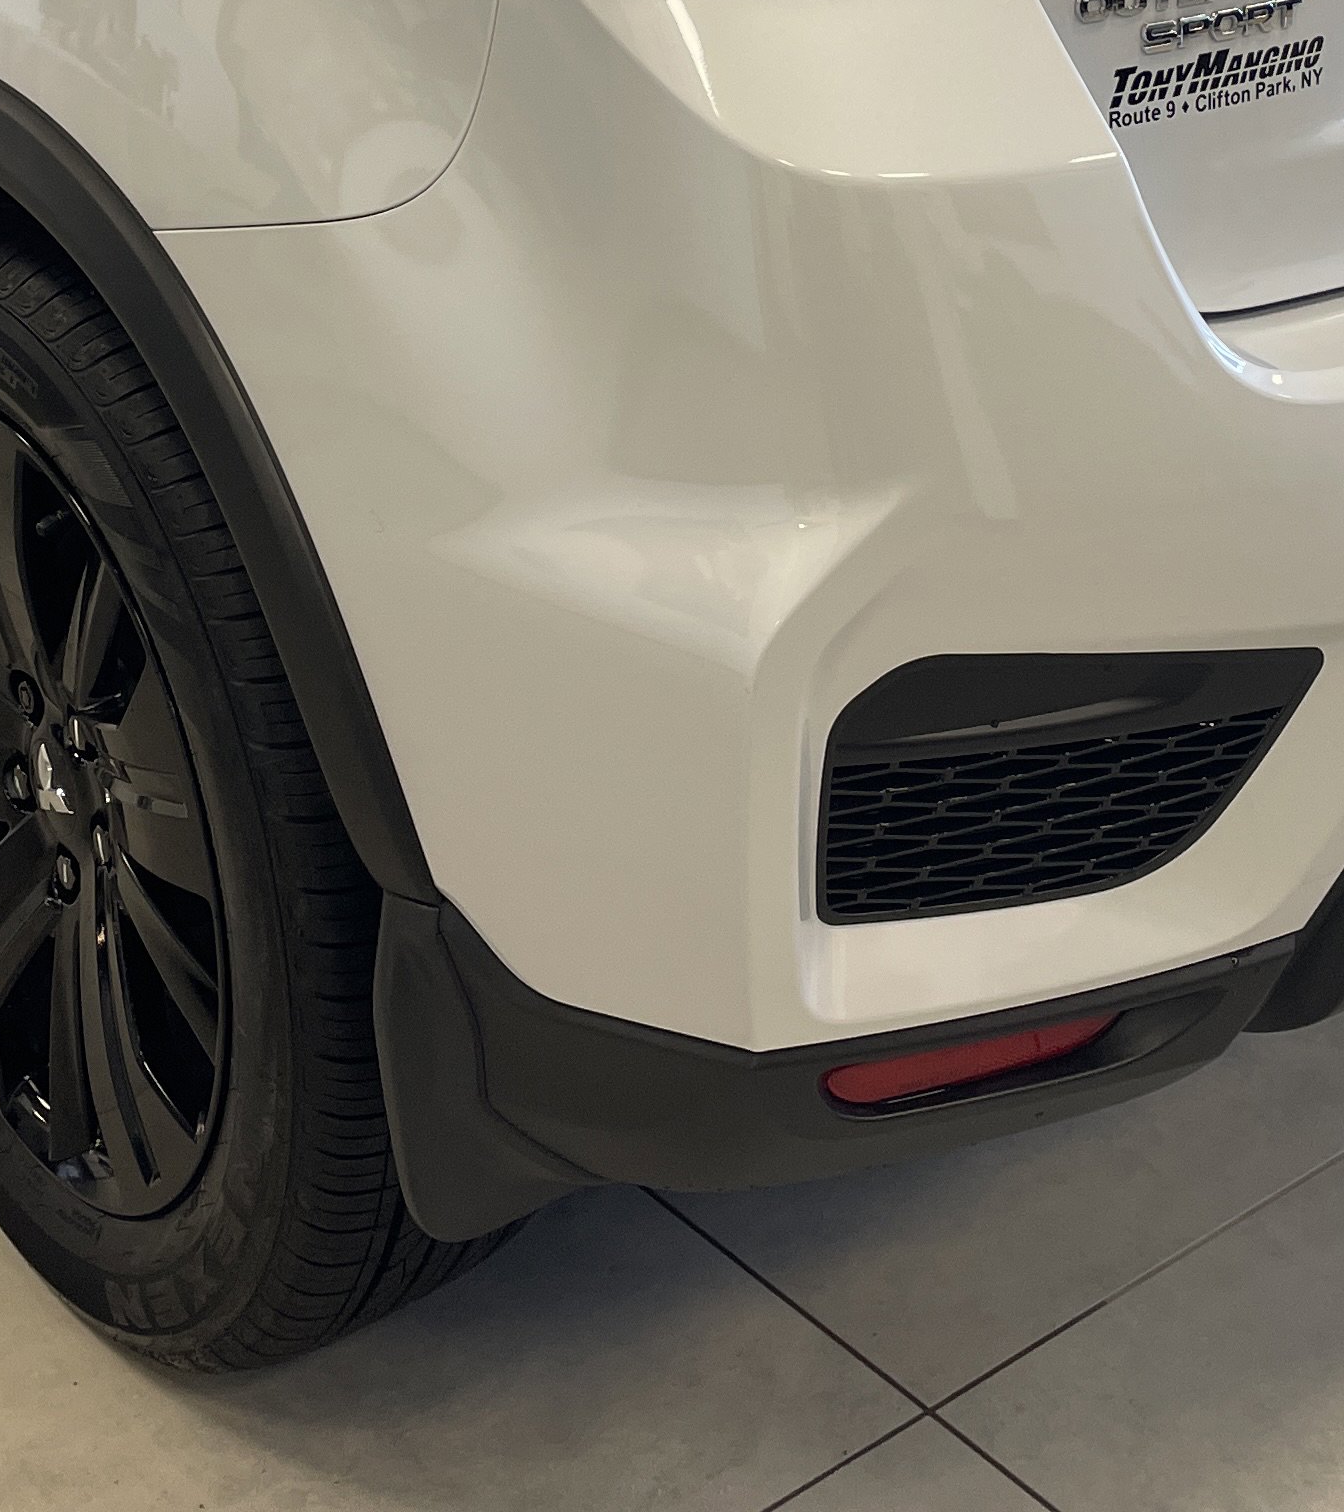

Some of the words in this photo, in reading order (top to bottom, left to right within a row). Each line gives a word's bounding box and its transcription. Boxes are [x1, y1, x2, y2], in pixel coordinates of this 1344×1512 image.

[1108, 106, 1161, 129] Route
[1166, 103, 1176, 119] 9
[1195, 89, 1251, 113] Clifton
[1255, 78, 1296, 100] Park,
[1300, 67, 1324, 89] NY
